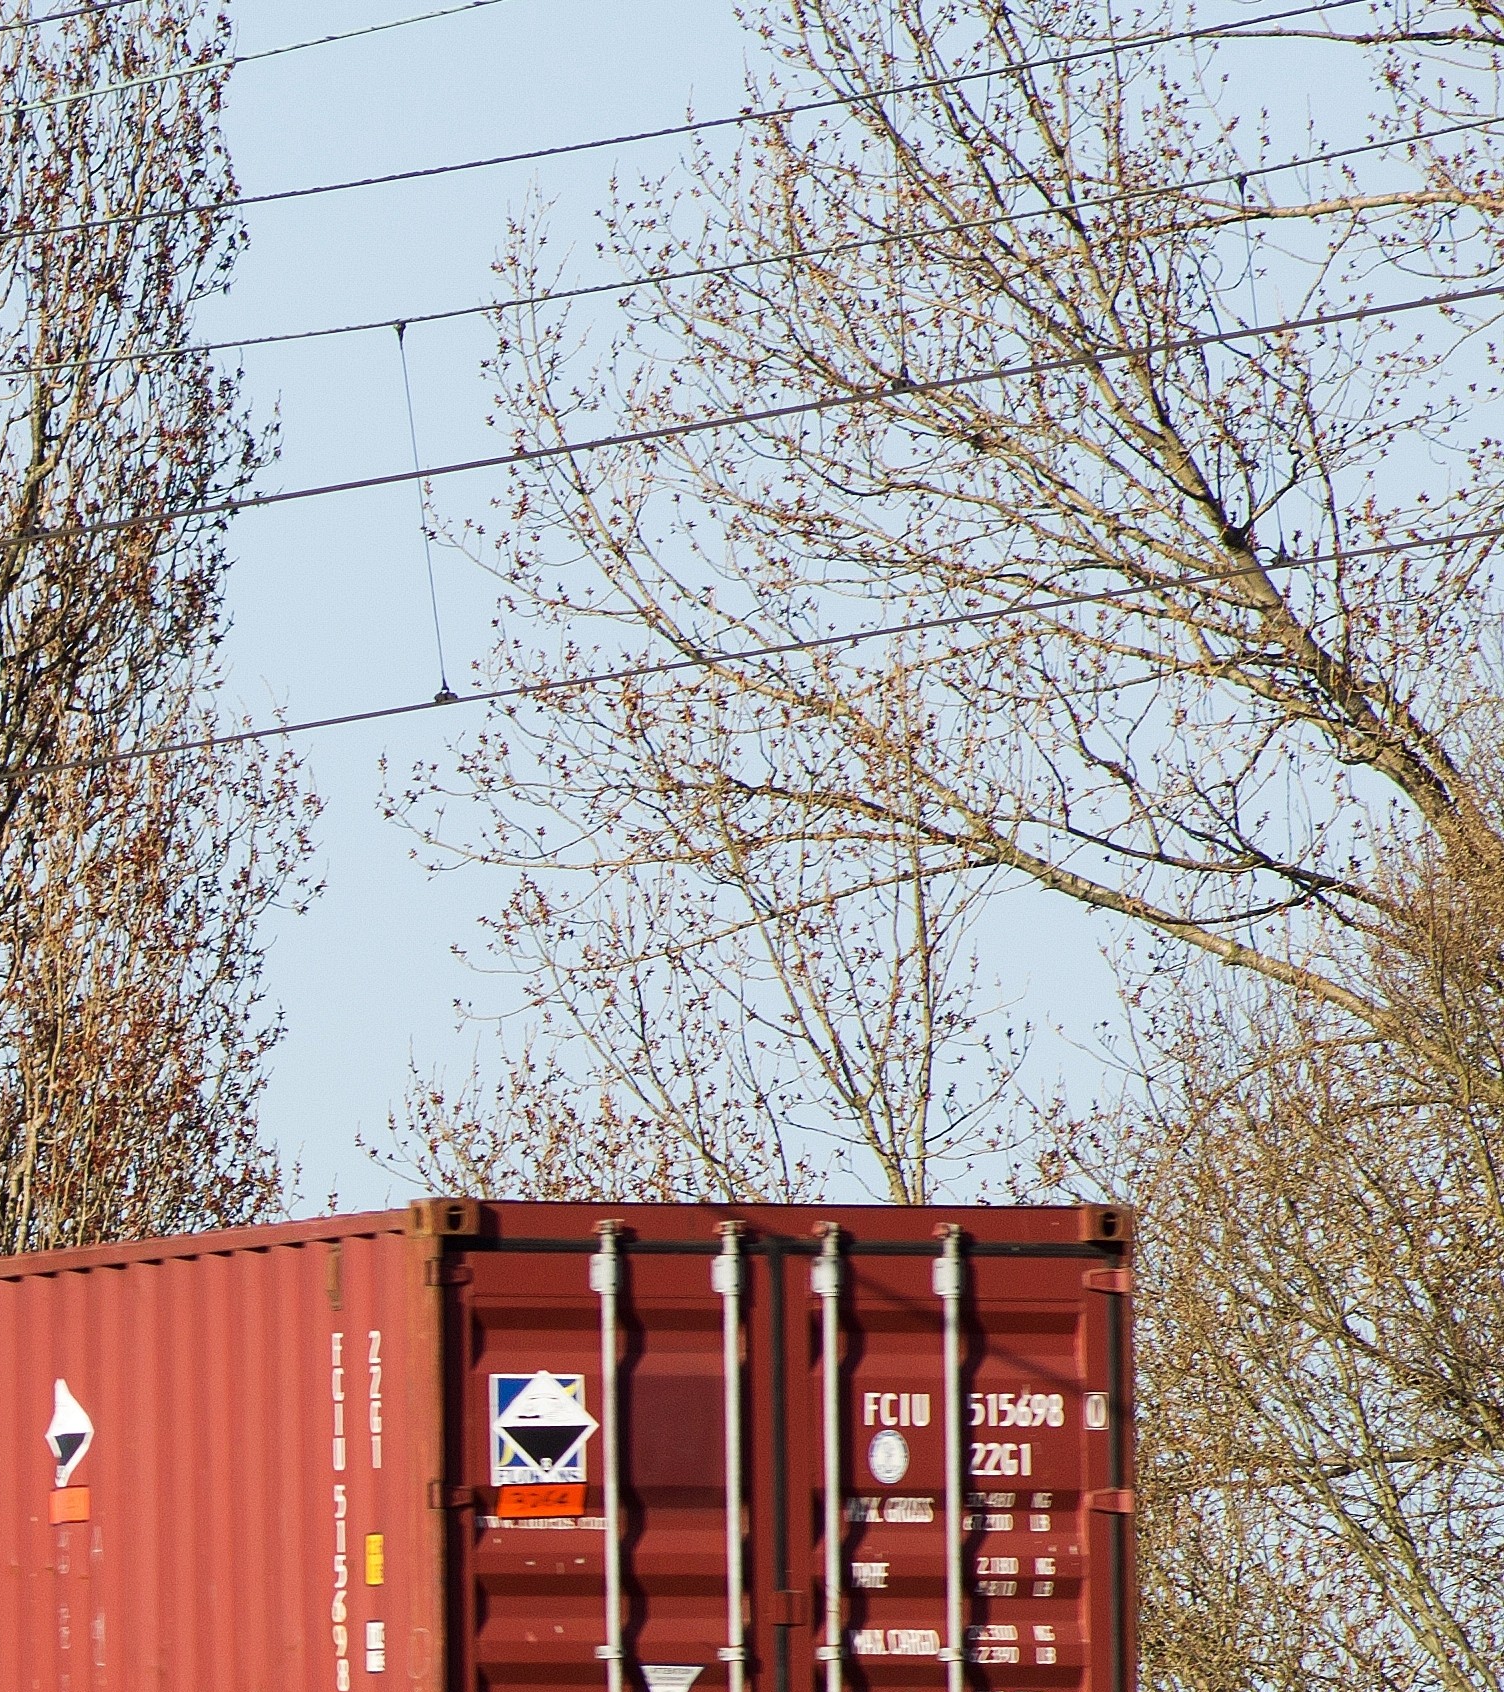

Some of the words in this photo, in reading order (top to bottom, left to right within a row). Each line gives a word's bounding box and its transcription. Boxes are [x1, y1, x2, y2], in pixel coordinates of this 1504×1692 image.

[863, 1391, 932, 1427] FCIU
[968, 1391, 1065, 1427] 515698
[968, 1442, 1032, 1476] 22G1
[331, 1484, 350, 1691] 515698
